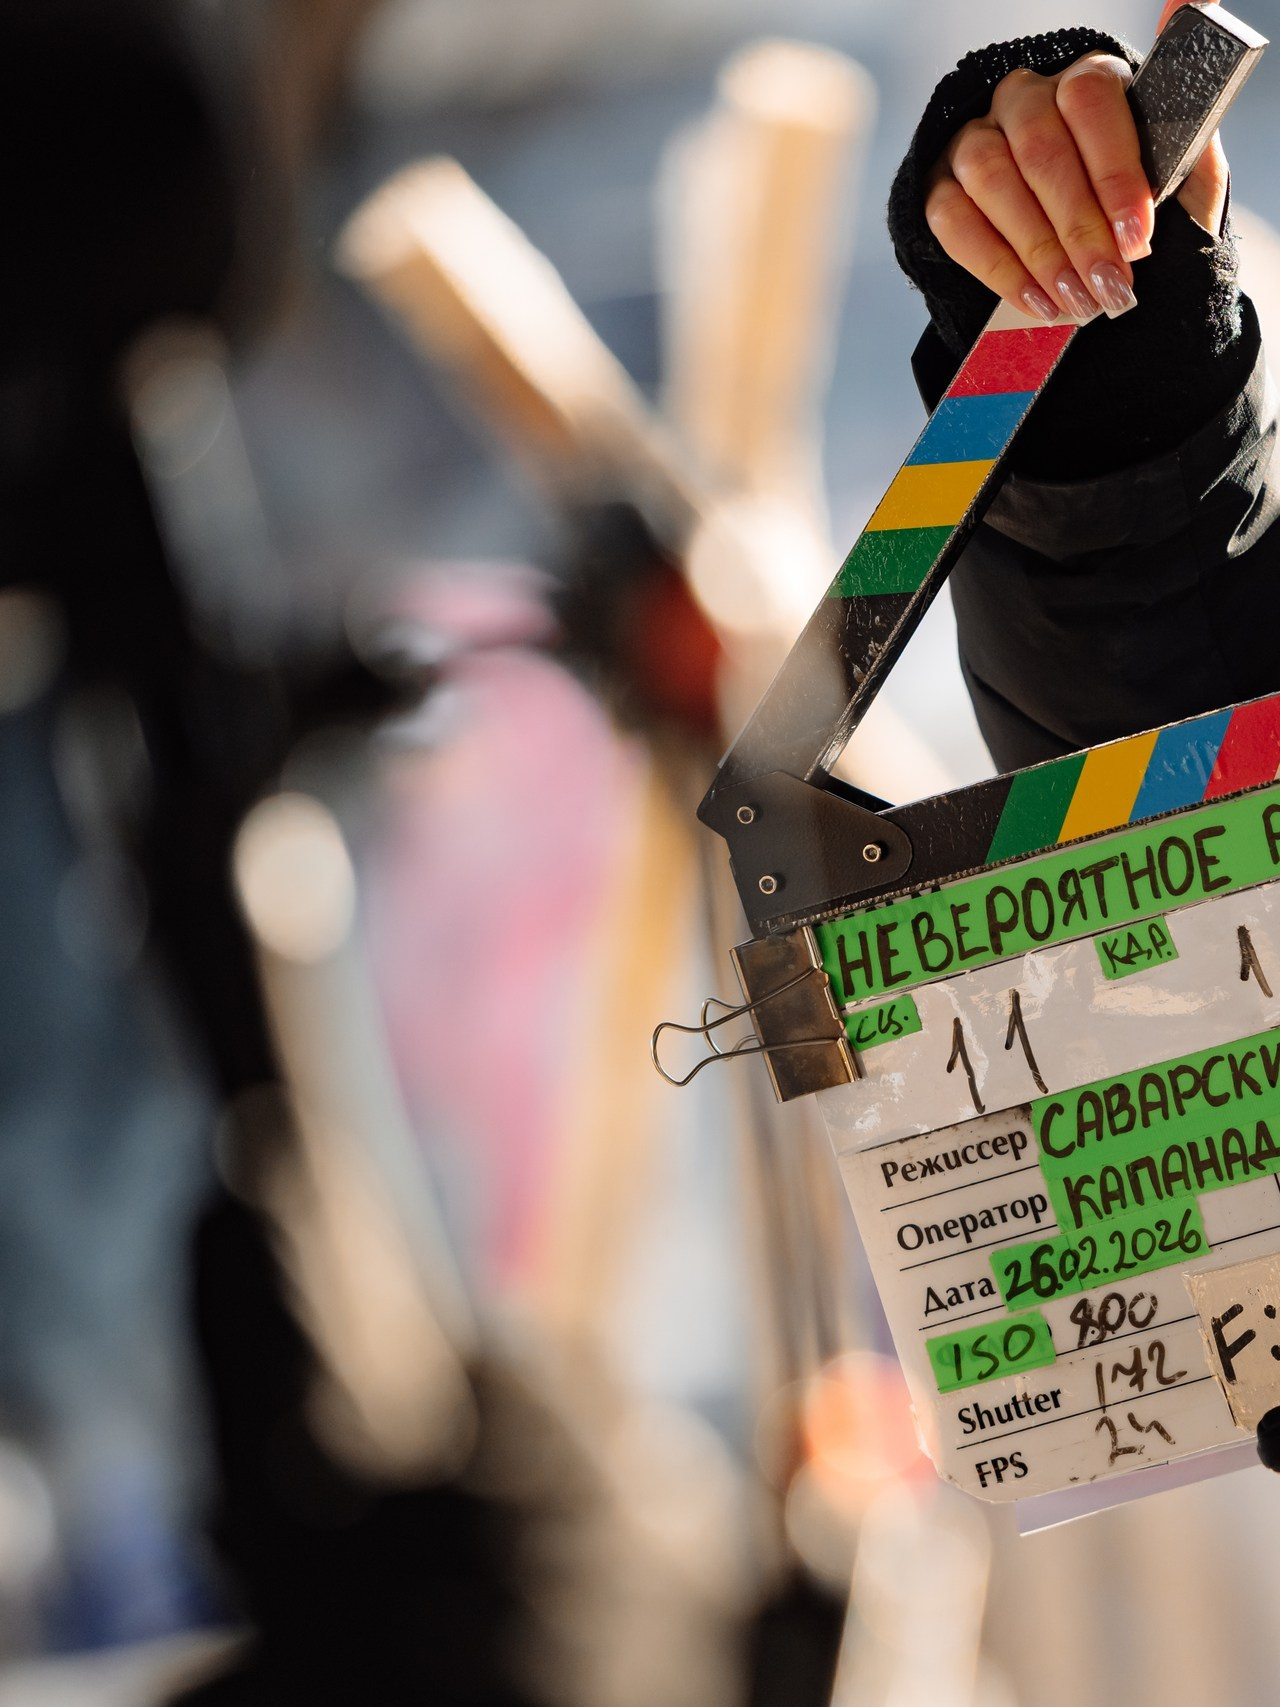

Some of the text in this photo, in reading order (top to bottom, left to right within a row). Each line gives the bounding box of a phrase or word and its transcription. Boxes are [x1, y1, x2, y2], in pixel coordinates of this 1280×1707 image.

[838, 825, 1232, 997] НЕВЕРОЯТНОЕ
[1237, 924, 1274, 998] 1
[881, 1129, 1029, 1188] Режиссер
[896, 1190, 1048, 1251] Оператор
[1004, 1208, 1201, 1302] 26.02.2026
[922, 1274, 997, 1317] Дата
[1095, 1340, 1187, 1413] 172
[956, 1384, 1063, 1435] Shutter
[974, 1451, 1029, 1489] FPS
